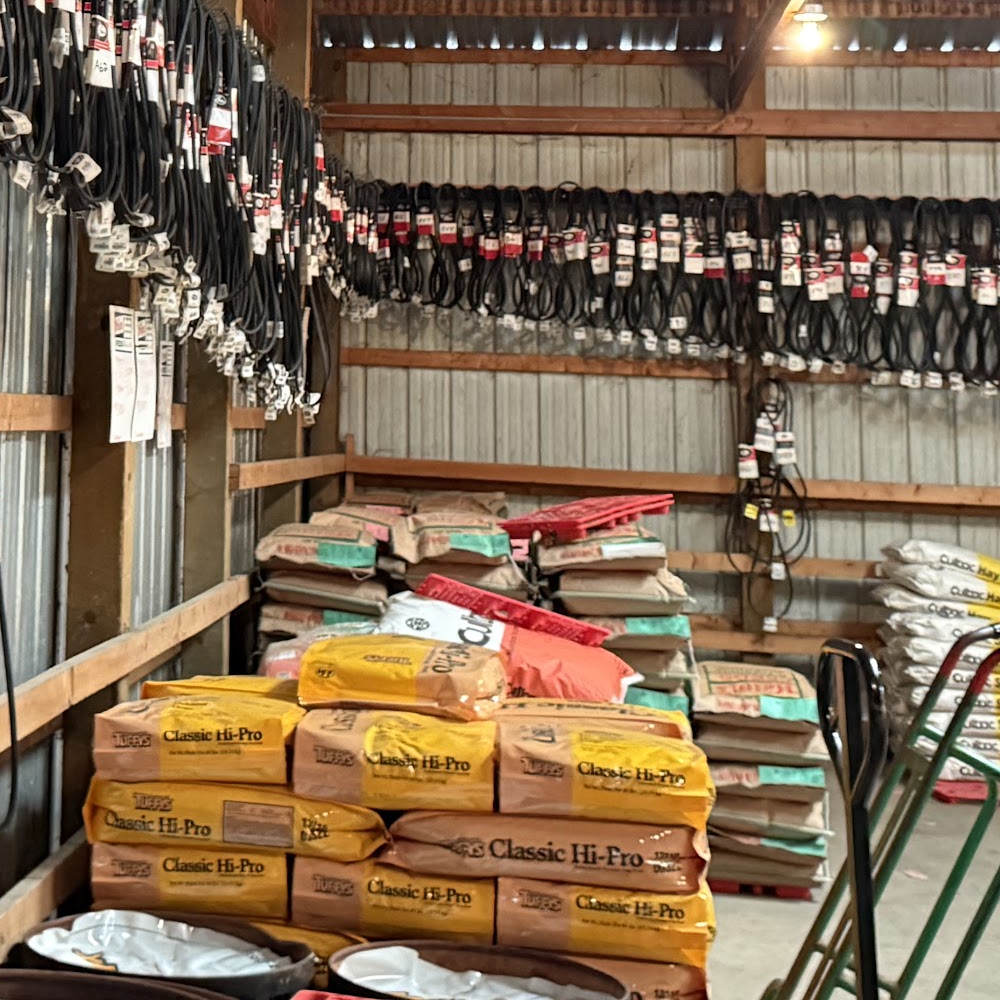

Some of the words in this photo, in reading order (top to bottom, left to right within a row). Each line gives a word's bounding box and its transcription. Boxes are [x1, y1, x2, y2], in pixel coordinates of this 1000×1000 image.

[163, 730, 212, 742] Classic
[216, 727, 263, 741] Hi-Pro
[366, 752, 417, 768] Classic
[422, 755, 471, 772] Hi-Pro
[577, 761, 632, 780] Classic
[635, 767, 686, 785] Hi-Pro
[104, 810, 154, 833] Classic
[158, 815, 212, 837] Hi-Pro
[489, 838, 565, 863] Classic
[572, 843, 644, 868] Hi-Pro
[162, 857, 213, 873] Classic
[217, 858, 265, 874] Hi-Pro
[367, 879, 420, 900] Classic
[423, 887, 472, 904] Hi-Pro
[575, 895, 630, 915] Classic
[635, 901, 685, 920] Hi-Pro
